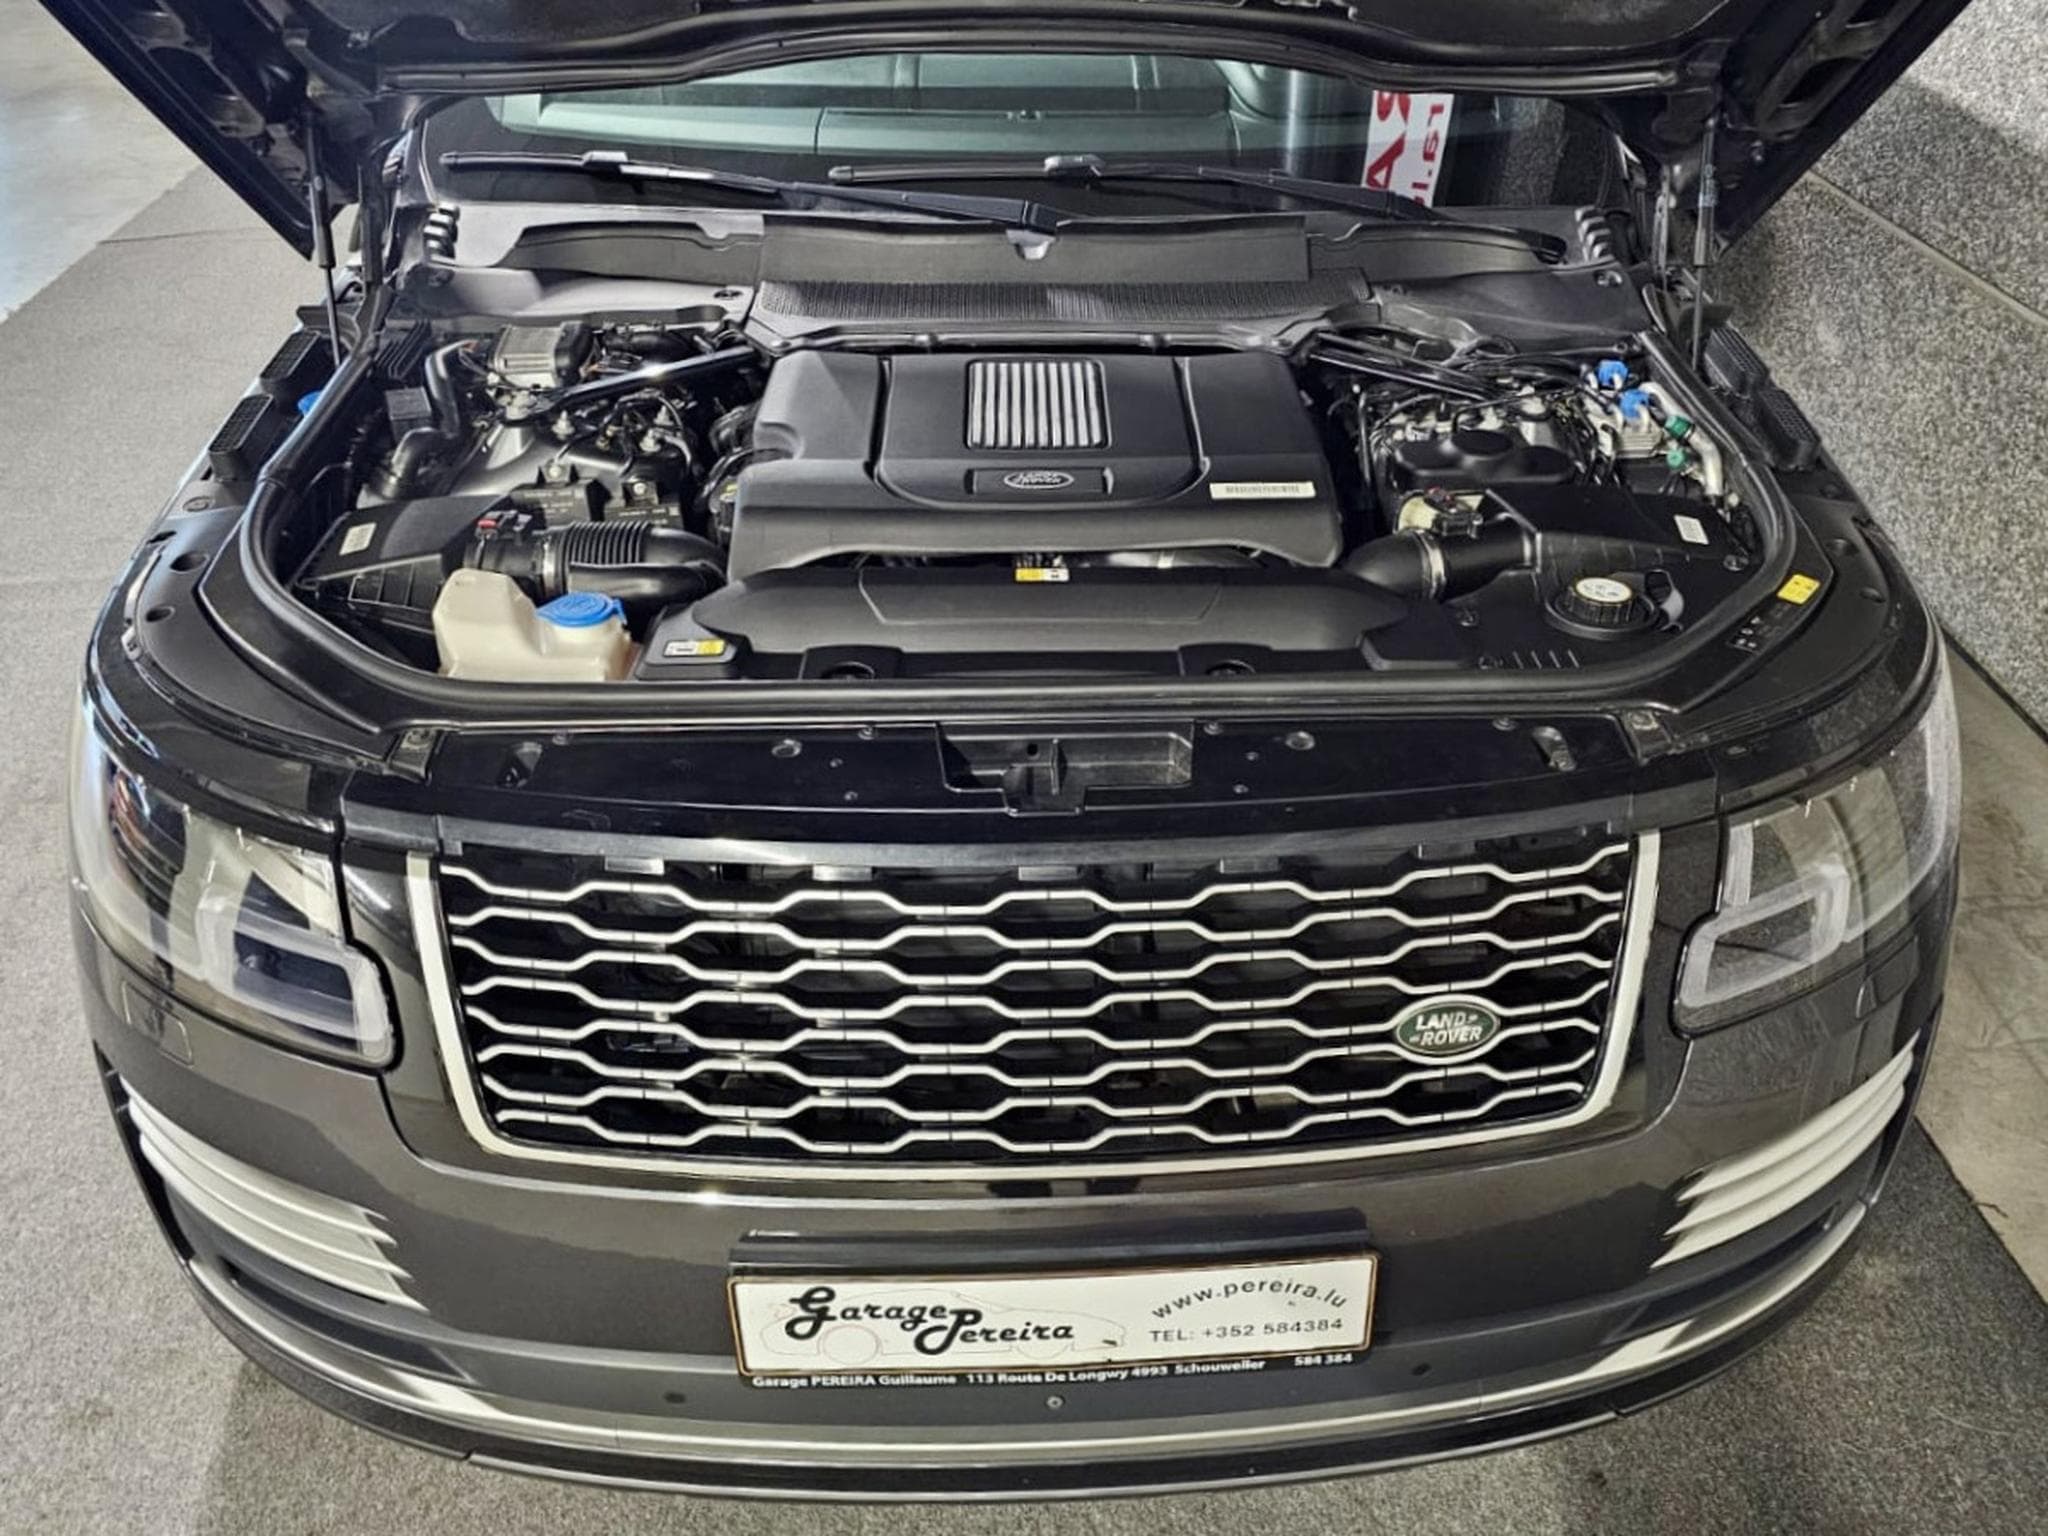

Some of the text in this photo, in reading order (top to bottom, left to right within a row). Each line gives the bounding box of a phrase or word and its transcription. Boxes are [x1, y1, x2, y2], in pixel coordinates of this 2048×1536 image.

[1416, 1012, 1466, 1030] LAND
[1420, 1025, 1483, 1046] ROVER
[784, 1286, 949, 1341] Garage
[1152, 1278, 1347, 1320] www.pereira.lu
[913, 1308, 1075, 1356] Pereira
[1150, 1318, 1344, 1343] TEL: +352 584384
[752, 1376, 808, 1389] Garage
[811, 1375, 876, 1386] PEREIRA
[878, 1374, 957, 1386] Guillaume
[997, 1372, 1043, 1384] Route
[1044, 1372, 1066, 1382] De
[1068, 1369, 1129, 1382] Longwy
[1131, 1365, 1168, 1377] 4993
[1174, 1358, 1265, 1375] Schouweiler
[1294, 1355, 1322, 1367] 584
[1324, 1353, 1354, 1365] 384
